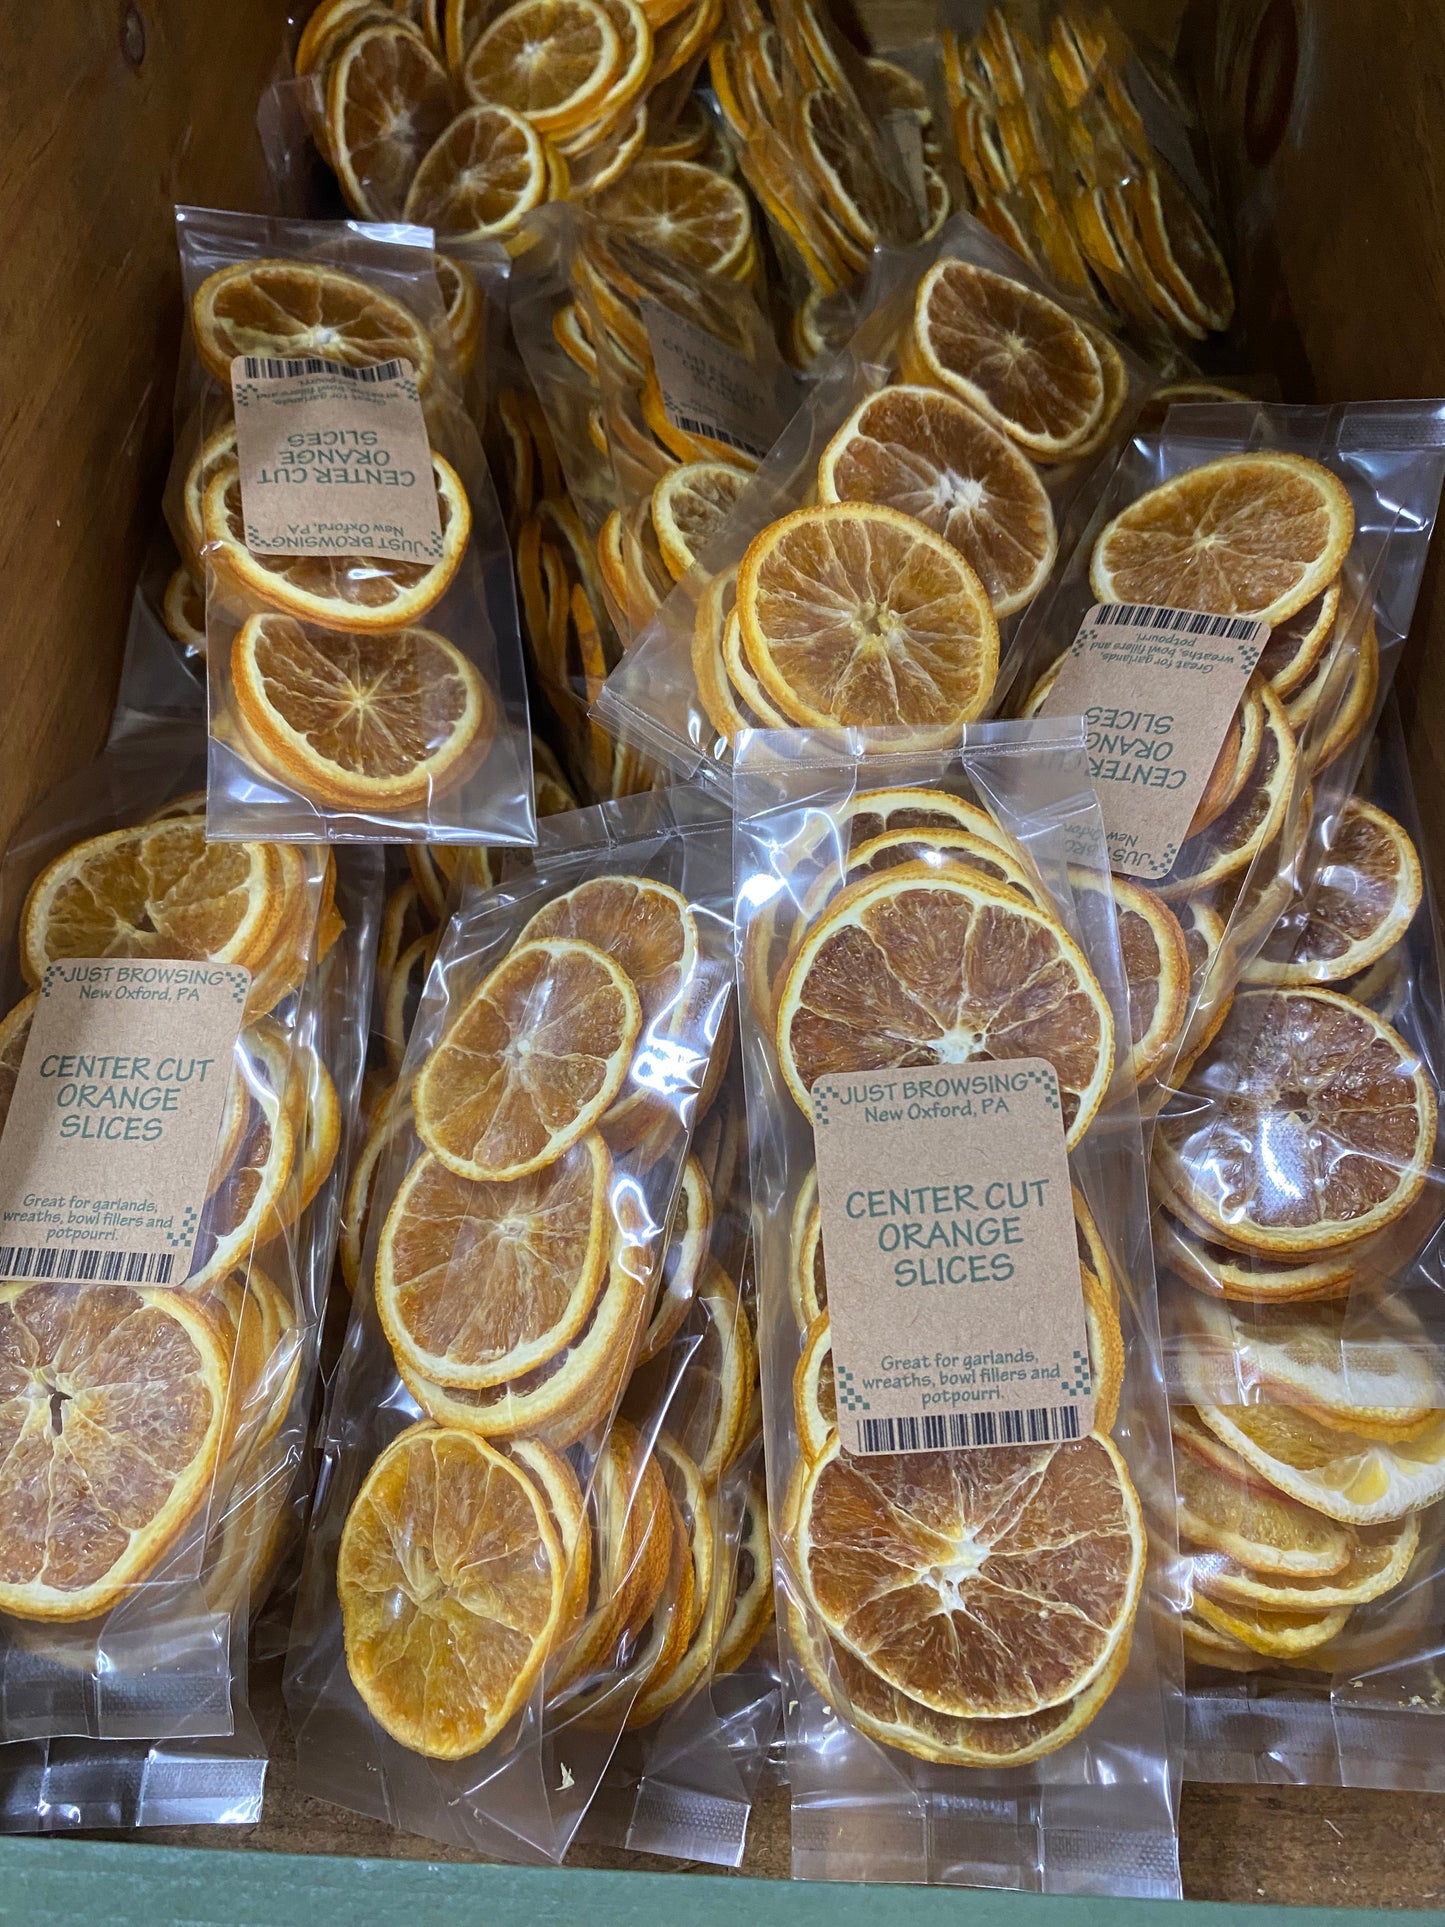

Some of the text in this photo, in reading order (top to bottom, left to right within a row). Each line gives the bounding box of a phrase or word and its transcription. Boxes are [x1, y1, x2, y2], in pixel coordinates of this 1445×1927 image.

[287, 431, 378, 447] SLICES
[279, 450, 390, 466] ORANGE
[257, 468, 416, 487] CENTER CUT
[287, 523, 404, 537] New Oxford, PA
[272, 535, 423, 557] JUST BROWSING
[1136, 633, 1197, 647] potpourri.
[1089, 641, 1234, 664] wreaths, bowl fillers and
[1101, 651, 1214, 674] Great for garlands,
[1085, 706, 1174, 735] SLICES
[1087, 731, 1174, 762] ORANG
[1085, 756, 1187, 789] CENTER
[1107, 831, 1138, 847] New
[1107, 846, 1150, 866] JUS
[64, 966, 225, 986] JUST BROWSING
[79, 986, 200, 1001] New Oxford, PA
[40, 1054, 215, 1082] CENTER CUT
[57, 1083, 181, 1111] ORANGE
[839, 1072, 1030, 1106] JUST BROWSING
[864, 1097, 1010, 1123] New Oxford, PA
[60, 1115, 163, 1141] SLICES
[23, 1194, 158, 1213] Great for garlands,
[845, 1178, 1050, 1219] CENTER CUT
[3, 1210, 173, 1228] wreaths, bowl fillers and
[46, 1229, 118, 1243] potpourri.
[878, 1216, 1024, 1253] ORANGE
[894, 1253, 1015, 1288] SLICES
[881, 1349, 1039, 1371] Great for garlands,
[862, 1363, 1061, 1391] wreaths, bowl fillers and
[921, 1388, 1004, 1409] potpourri.
